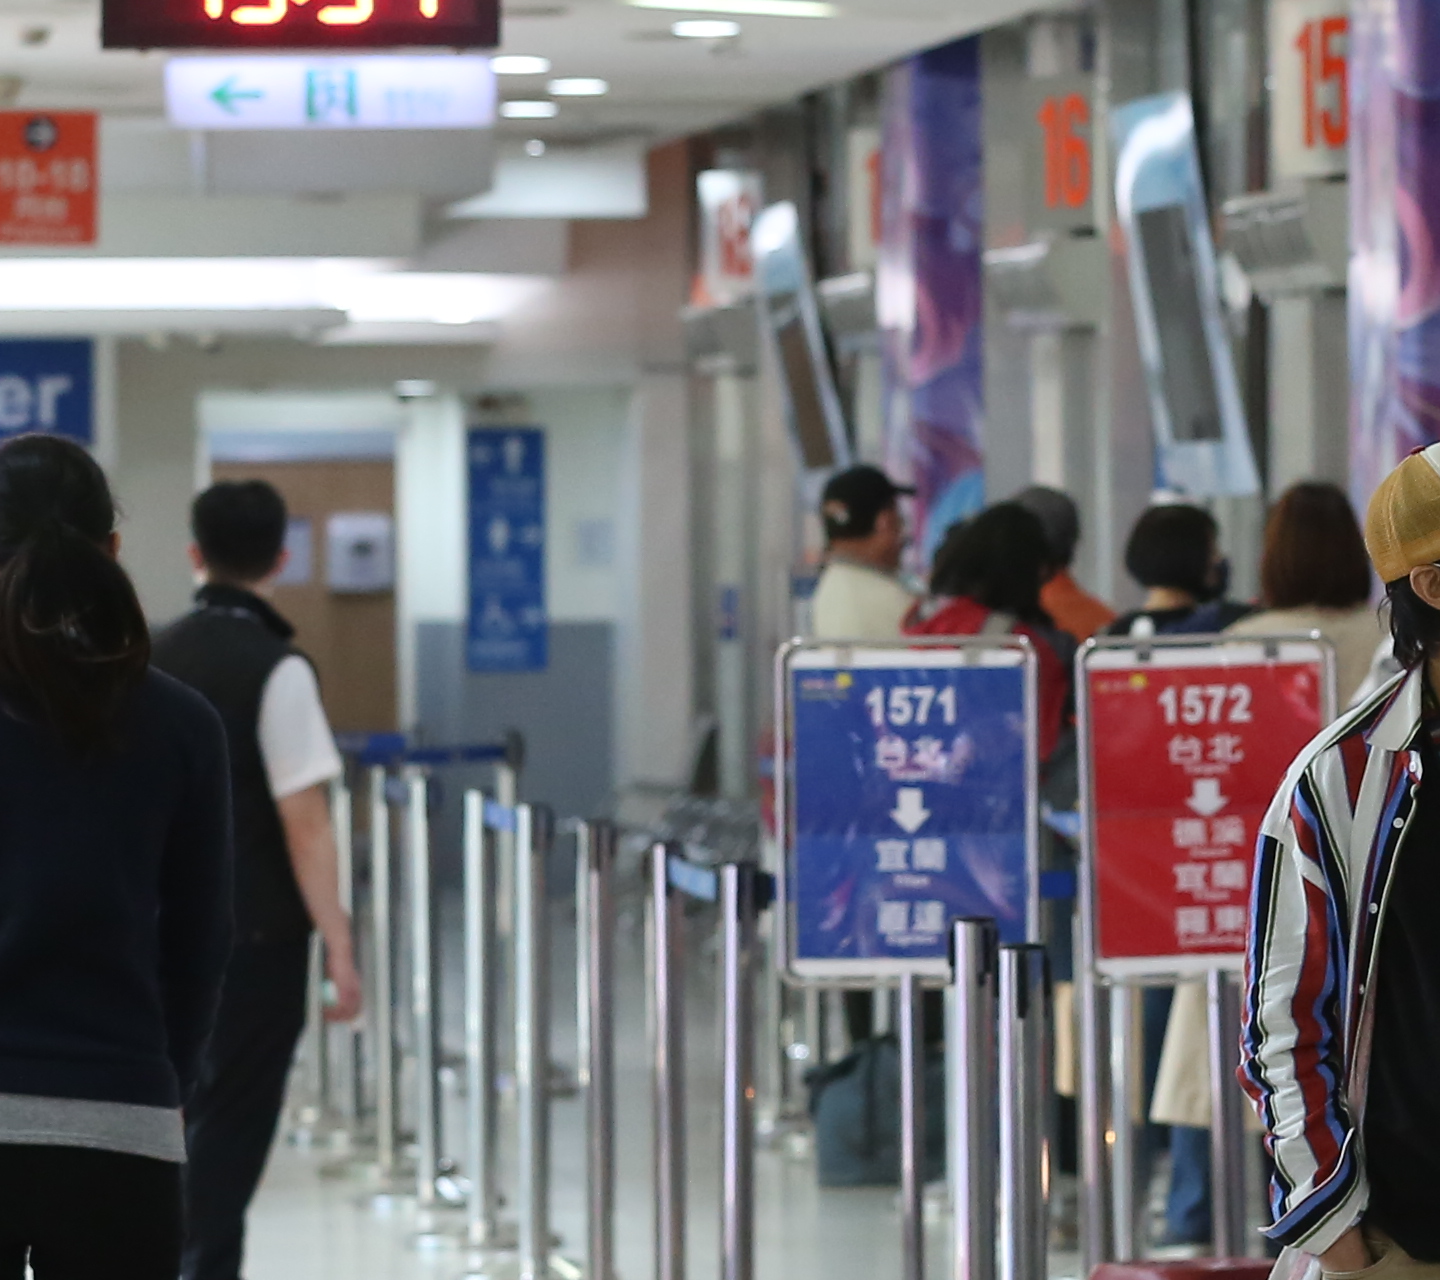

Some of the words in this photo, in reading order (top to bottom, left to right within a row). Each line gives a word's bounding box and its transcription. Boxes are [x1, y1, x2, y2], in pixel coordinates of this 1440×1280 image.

[1295, 16, 1349, 149] 15
[1038, 94, 1092, 210] 16
[864, 685, 957, 727] 1571
[1157, 683, 1253, 725] 1572
